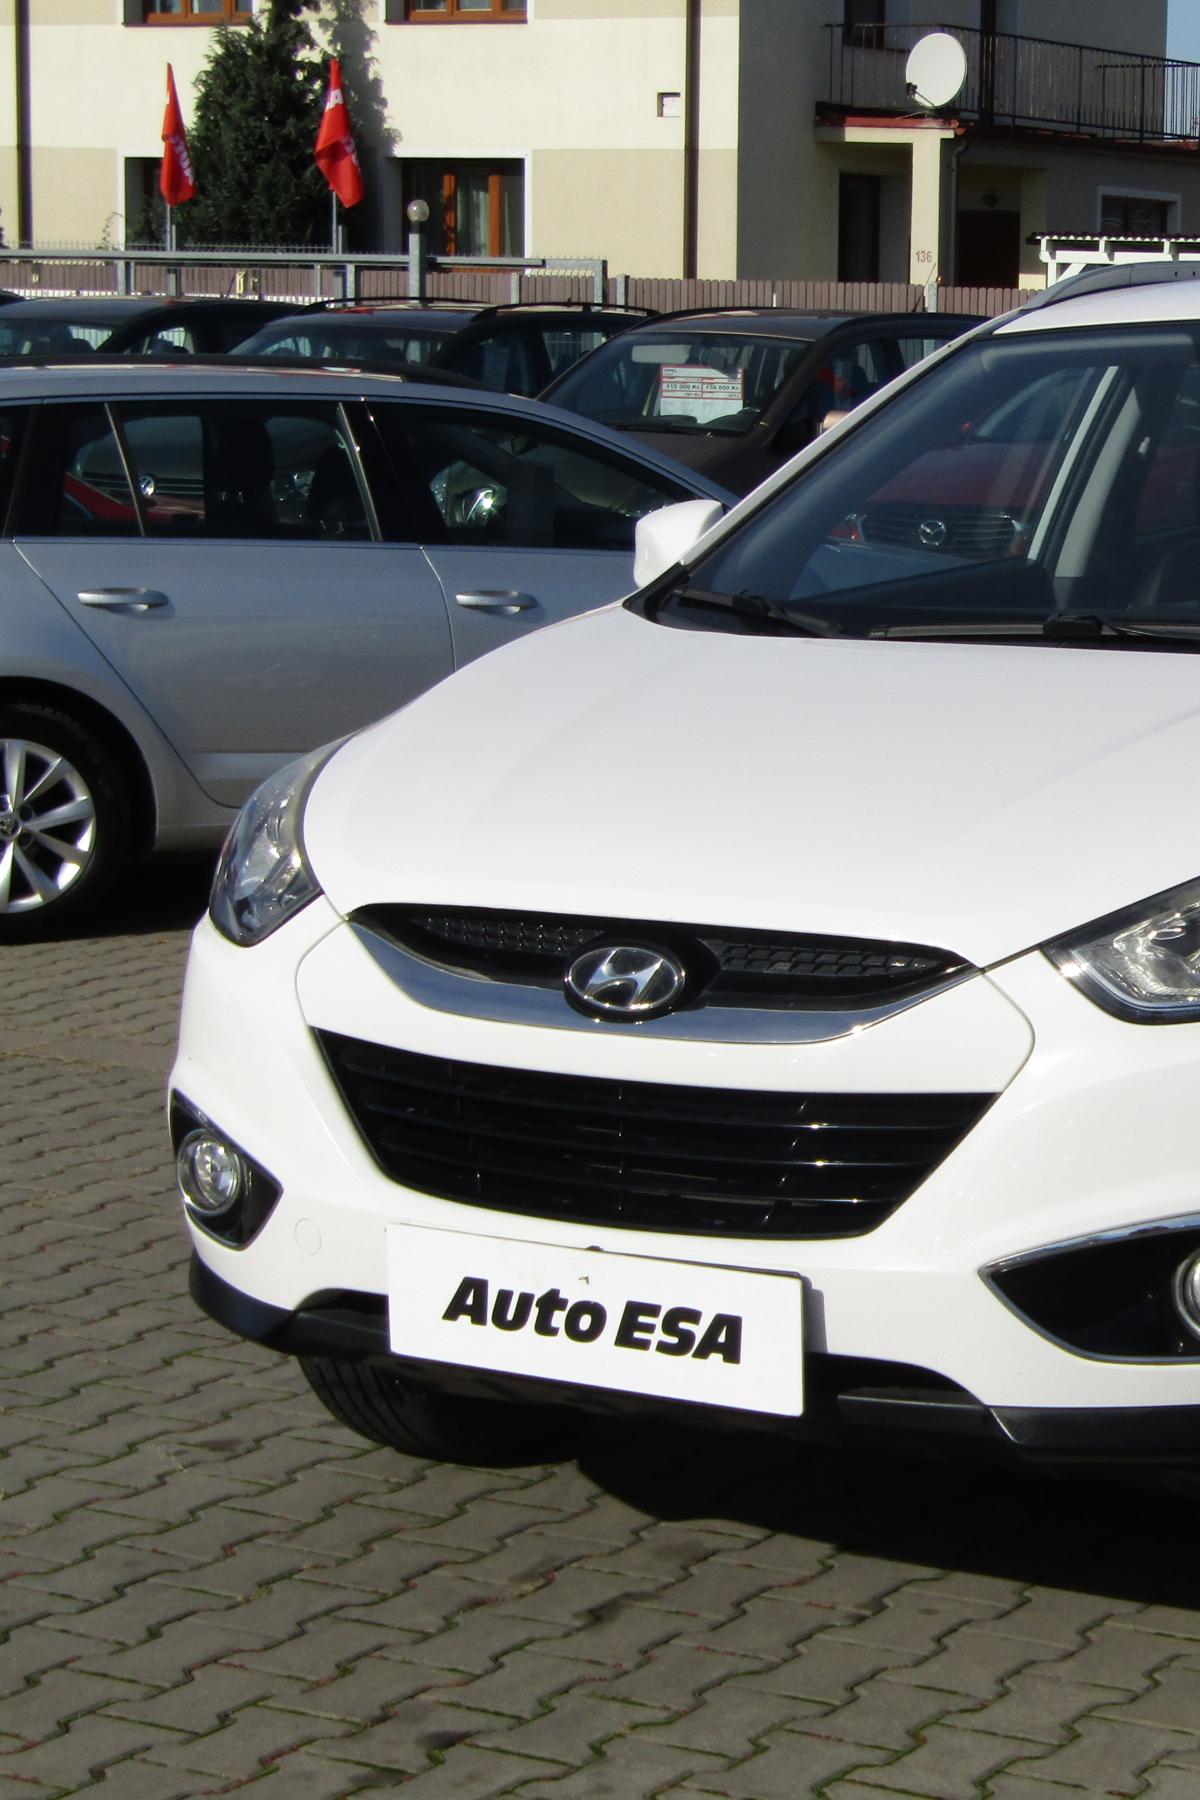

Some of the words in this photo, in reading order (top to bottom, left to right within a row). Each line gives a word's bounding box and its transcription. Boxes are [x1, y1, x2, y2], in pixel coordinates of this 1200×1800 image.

[915, 250, 932, 263] 136
[442, 1276, 607, 1343] Auto
[614, 1300, 743, 1364] ESA
